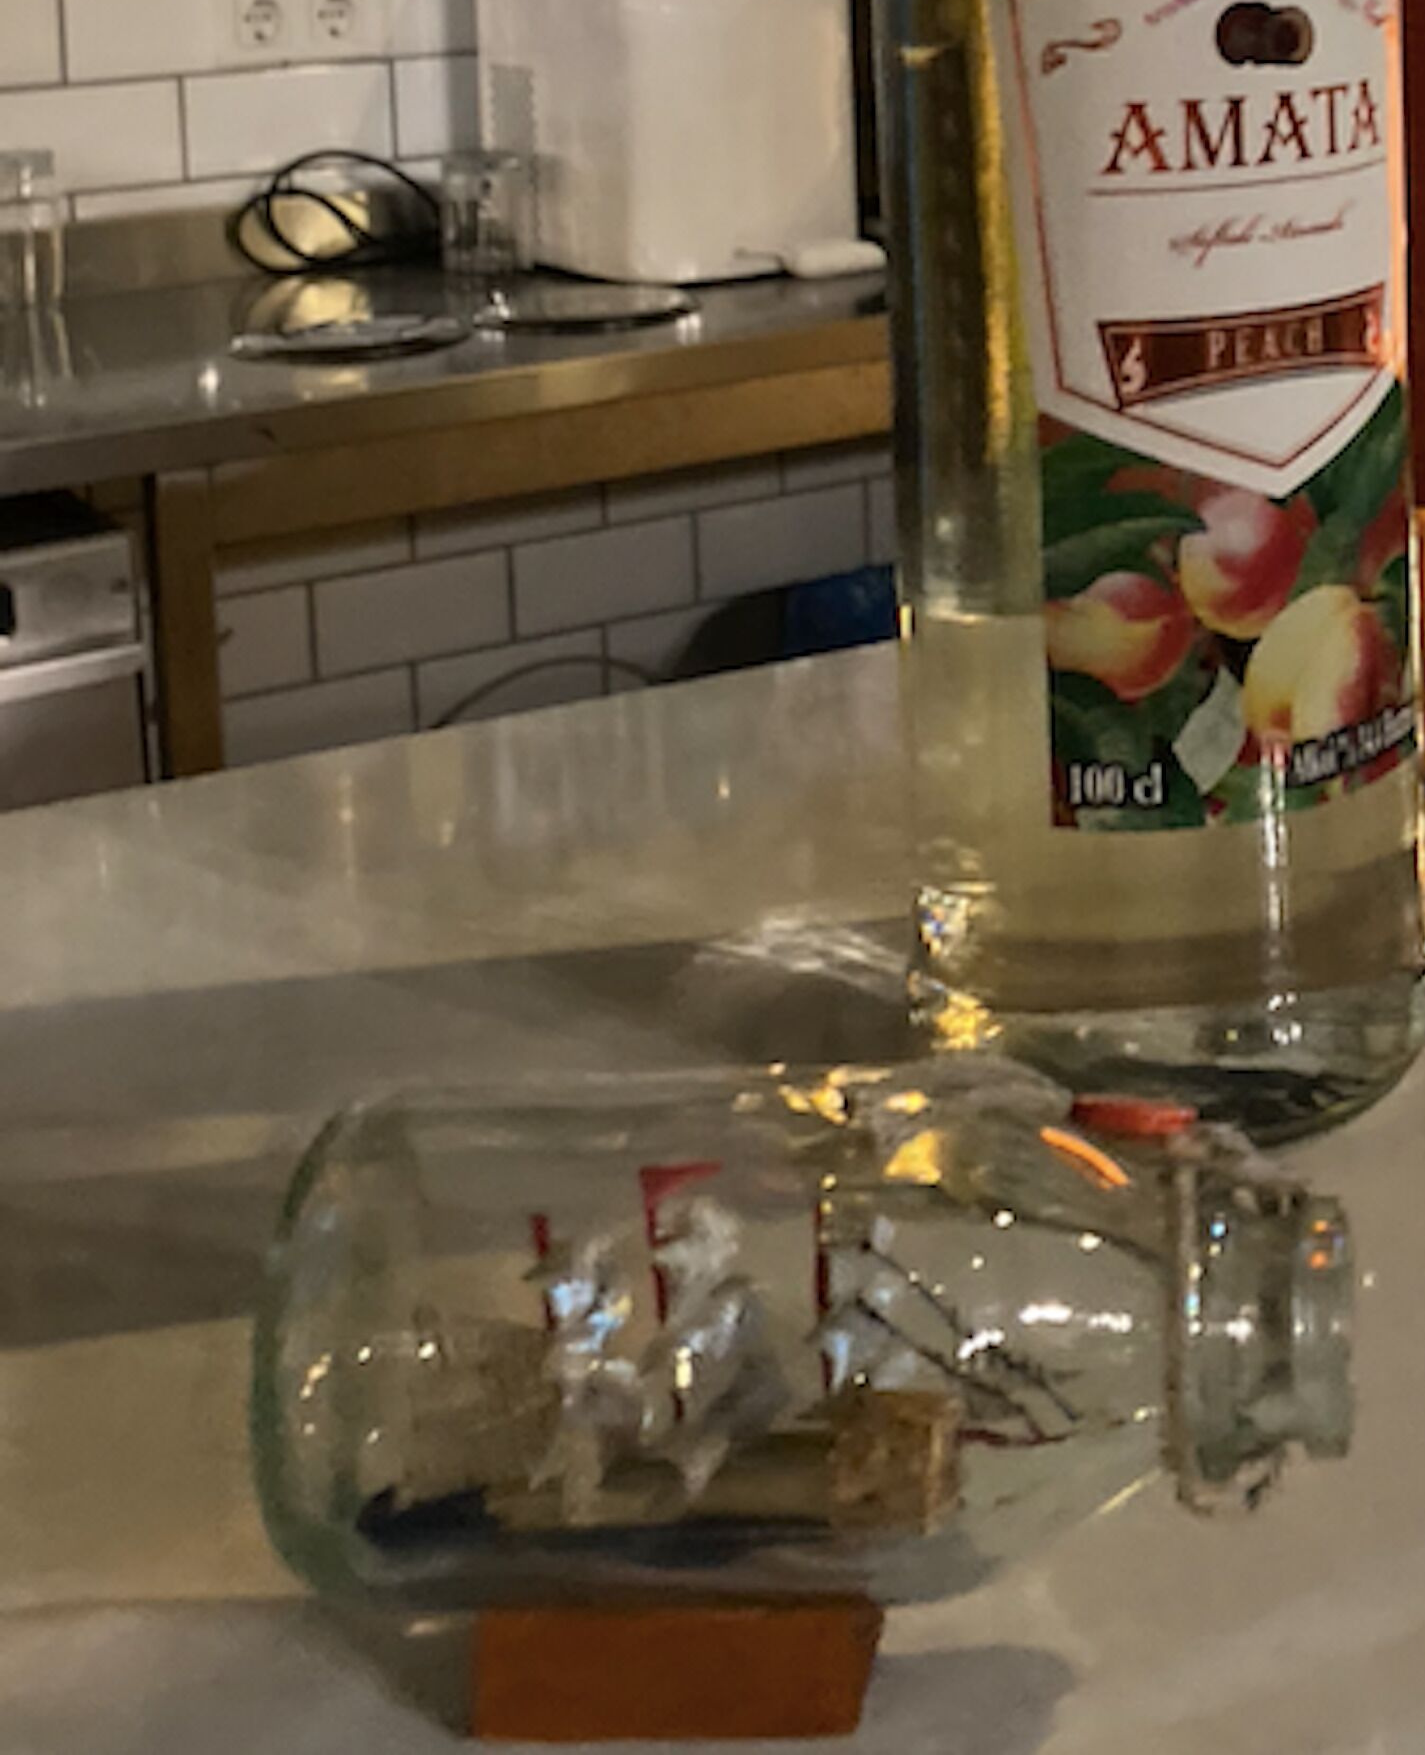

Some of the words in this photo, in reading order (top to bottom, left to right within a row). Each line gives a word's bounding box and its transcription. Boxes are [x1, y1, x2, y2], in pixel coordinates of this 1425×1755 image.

[1098, 77, 1381, 174] AMATA
[1207, 314, 1325, 368] PEACH
[1068, 761, 1126, 805] 100
